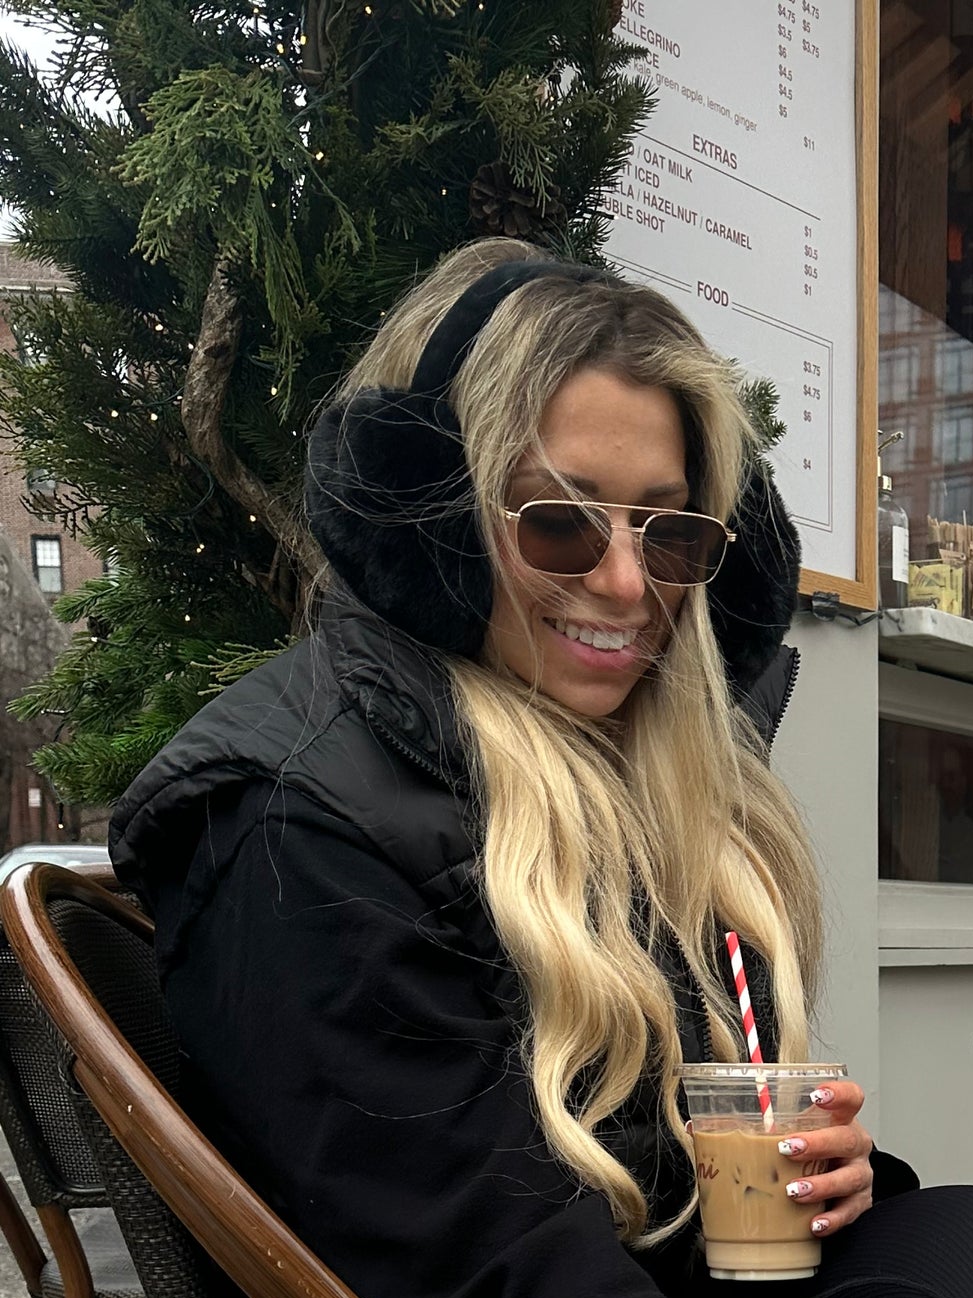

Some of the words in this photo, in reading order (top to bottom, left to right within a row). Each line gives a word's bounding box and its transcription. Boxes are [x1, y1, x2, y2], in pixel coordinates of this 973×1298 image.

[778, 3, 795, 24] $4.75
[802, 39, 819, 58] $3.75
[778, 64, 792, 81] $4.5
[778, 83, 792, 100] $4.5
[655, 73, 680, 92] green
[734, 112, 757, 132] ginger
[693, 134, 738, 170] EXTRAS
[803, 136, 814, 151] $11
[643, 149, 666, 169] OAT
[668, 159, 693, 183] MILK
[635, 165, 660, 188] ICED
[636, 209, 666, 233] SHOT
[643, 191, 698, 226] HAZELNUT
[705, 218, 752, 250] CARAMEL
[804, 226, 812, 238] $1
[804, 245, 818, 260] $0.5
[804, 264, 818, 279] $0.5
[697, 280, 729, 307] FOOD
[804, 283, 812, 296] $1
[803, 361, 821, 376] $3.75
[803, 384, 821, 400] $4.75
